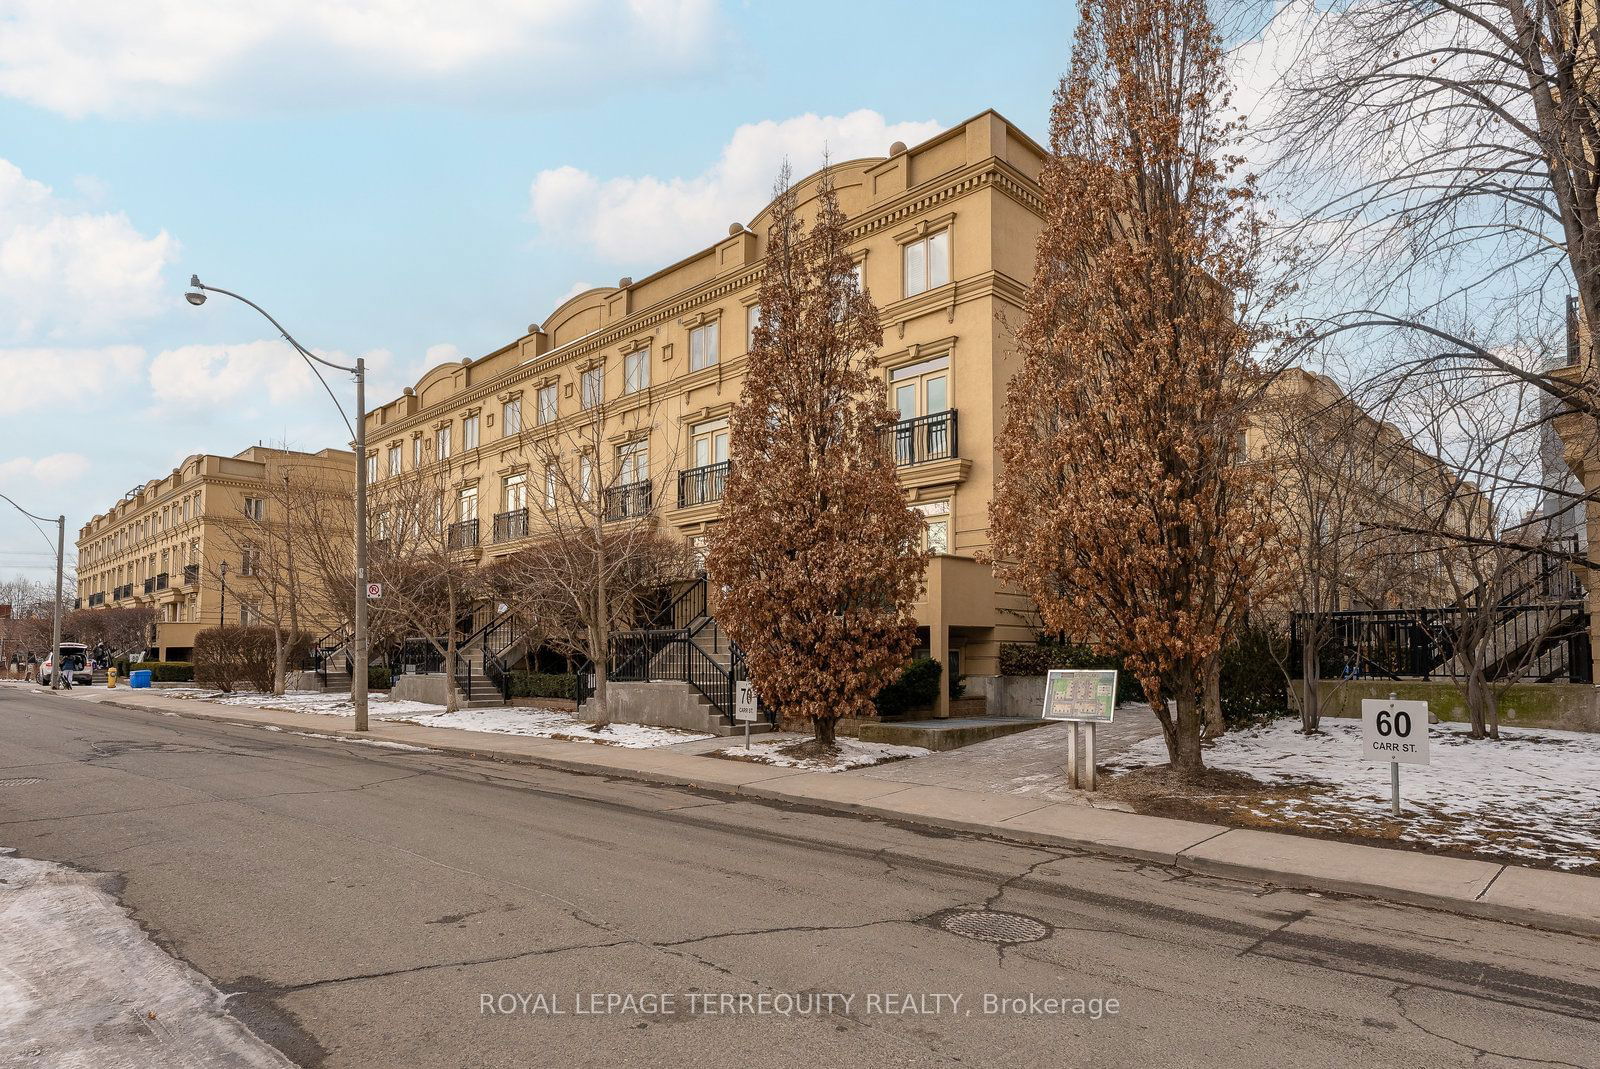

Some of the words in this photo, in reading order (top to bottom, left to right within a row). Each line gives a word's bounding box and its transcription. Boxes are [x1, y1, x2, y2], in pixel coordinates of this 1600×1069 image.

[1376, 710, 1411, 737] 60
[1372, 741, 1399, 752] CARR
[1402, 743, 1417, 753] ST.
